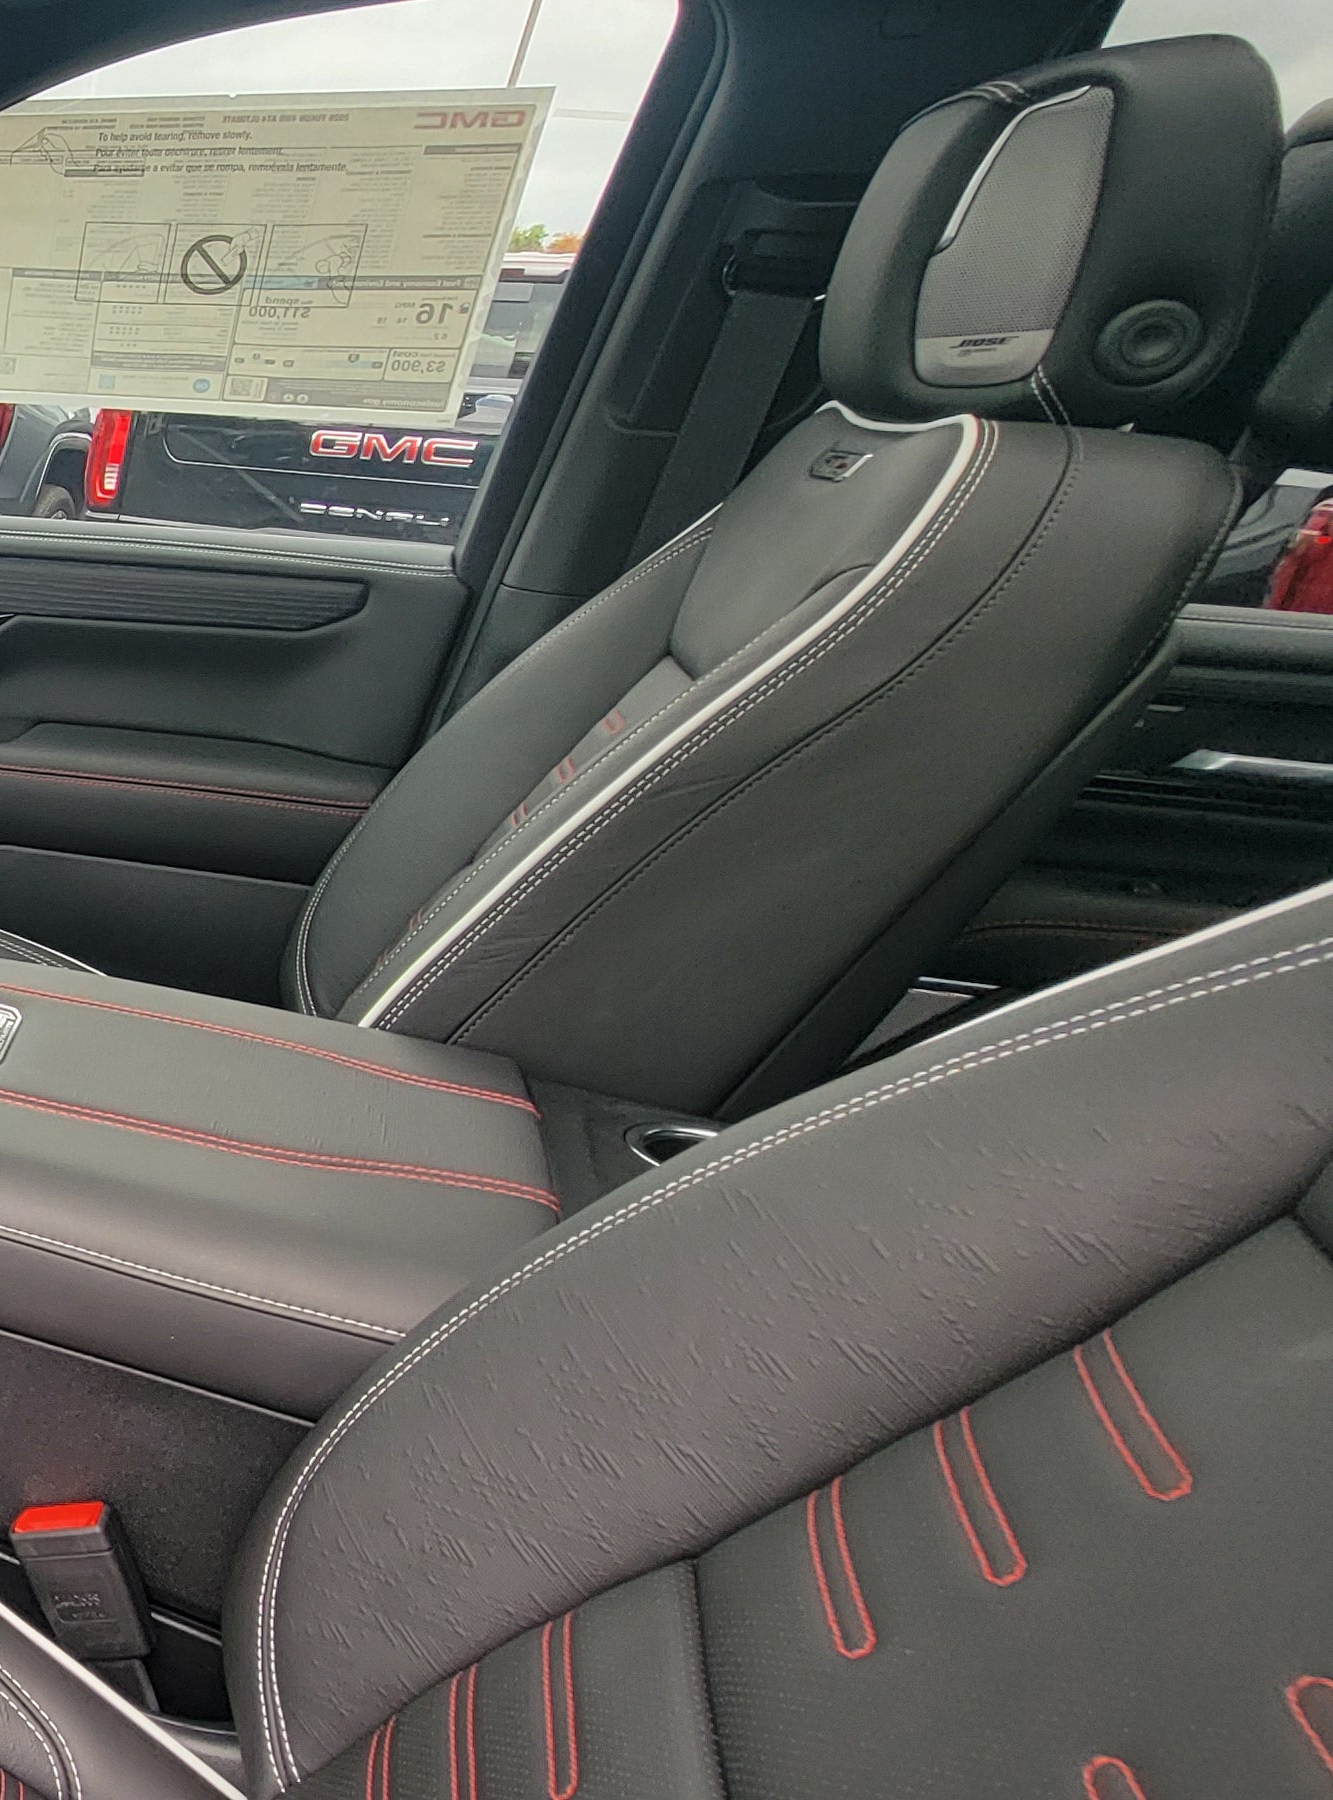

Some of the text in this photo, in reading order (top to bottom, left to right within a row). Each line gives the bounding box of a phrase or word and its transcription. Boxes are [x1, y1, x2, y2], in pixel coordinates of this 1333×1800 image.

[98, 132, 109, 141] To
[110, 132, 128, 143] help
[129, 132, 153, 141] avoid
[188, 132, 220, 140] remove
[222, 131, 253, 141] slowly.
[160, 163, 183, 172] evitar
[185, 164, 201, 174] que
[952, 336, 1017, 348] BOSE
[309, 429, 480, 469] GMC
[300, 503, 450, 527] DENALI
